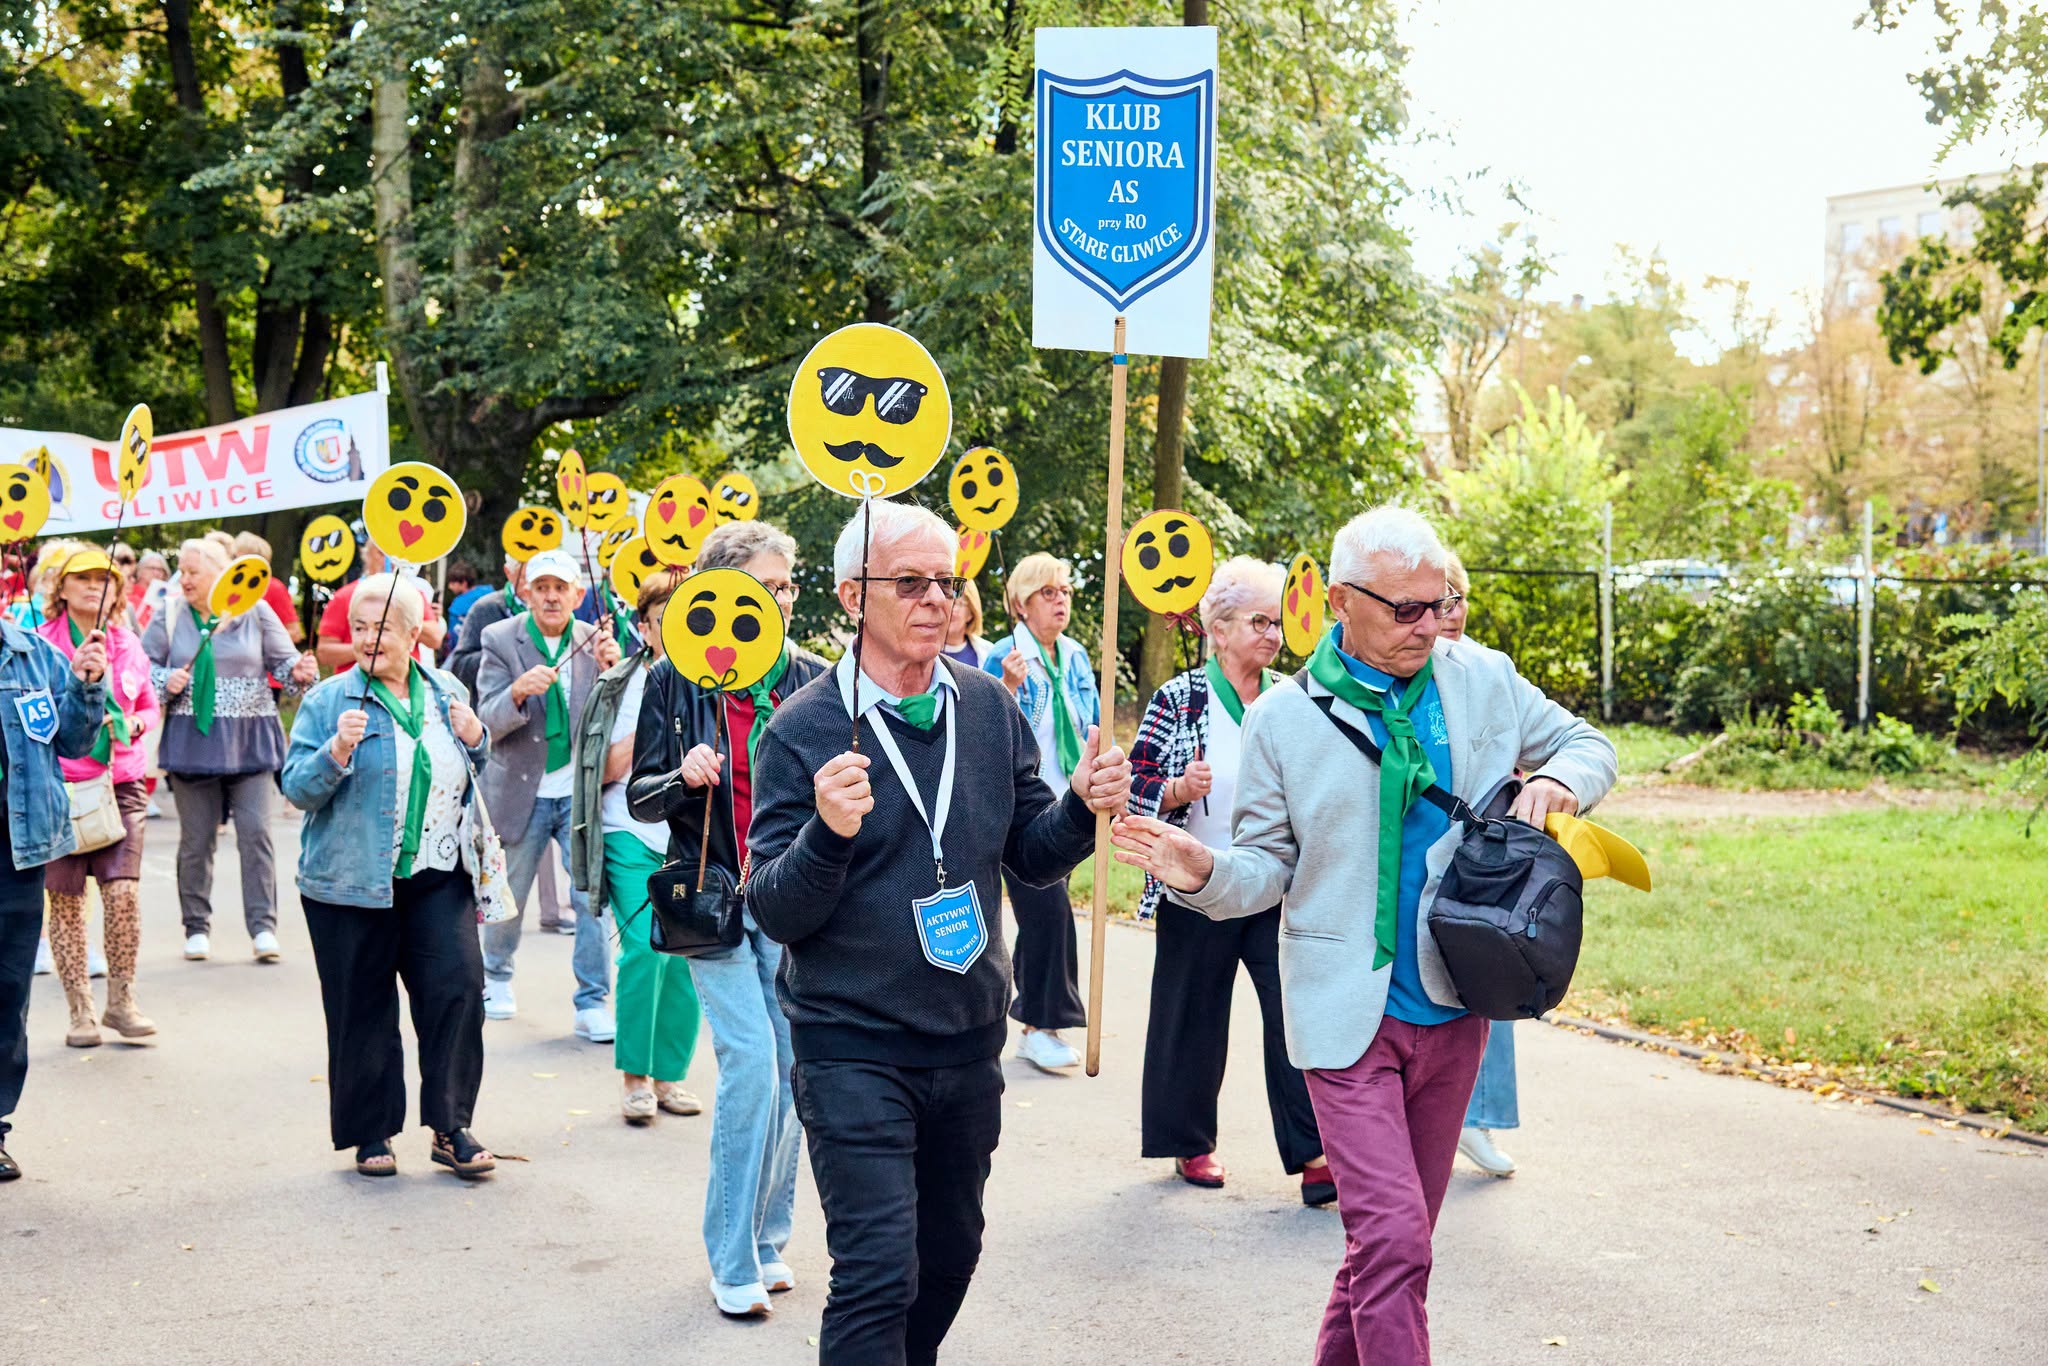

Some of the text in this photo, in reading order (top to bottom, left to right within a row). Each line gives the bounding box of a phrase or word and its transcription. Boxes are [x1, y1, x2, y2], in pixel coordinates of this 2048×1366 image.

[1085, 103, 1161, 131] KLUB
[1061, 139, 1185, 169] SENIORA
[1108, 179, 1139, 204] AS
[1098, 213, 1147, 230] przy RO
[1059, 217, 1183, 263] STARE GLIWICE
[101, 479, 274, 520] GLIWICE
[28, 701, 51, 723] AS
[926, 904, 971, 928] AKTYWNY
[935, 919, 969, 938] SENIOR
[934, 934, 980, 957] STARE GLIWICE
